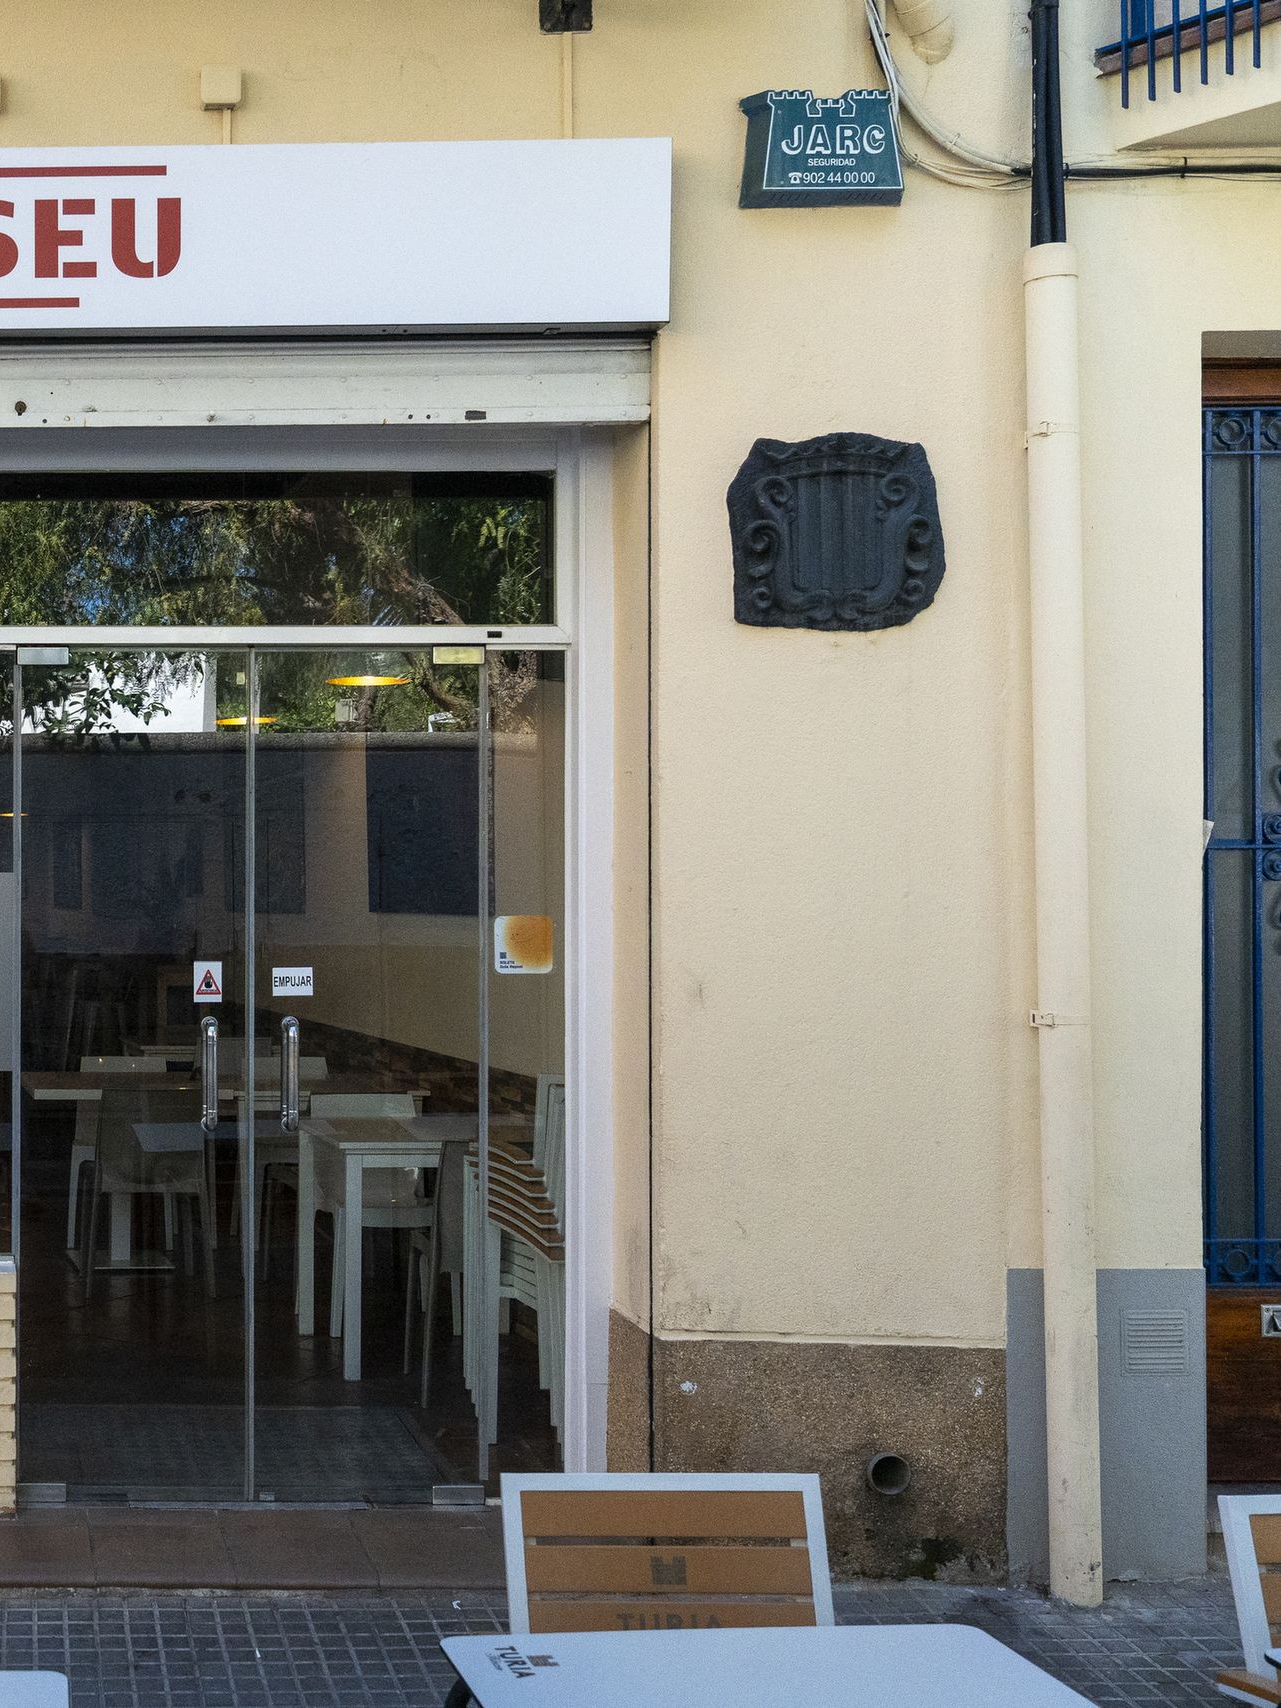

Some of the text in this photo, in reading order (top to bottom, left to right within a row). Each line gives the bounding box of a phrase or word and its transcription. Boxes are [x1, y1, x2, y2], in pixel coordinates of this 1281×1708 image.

[781, 124, 886, 155] JARC
[807, 158, 856, 166] SEGURIDAD
[803, 172, 875, 184] 902 44 00 00
[273, 976, 312, 988] EMPUJAR
[494, 1645, 536, 1678] TURIA
